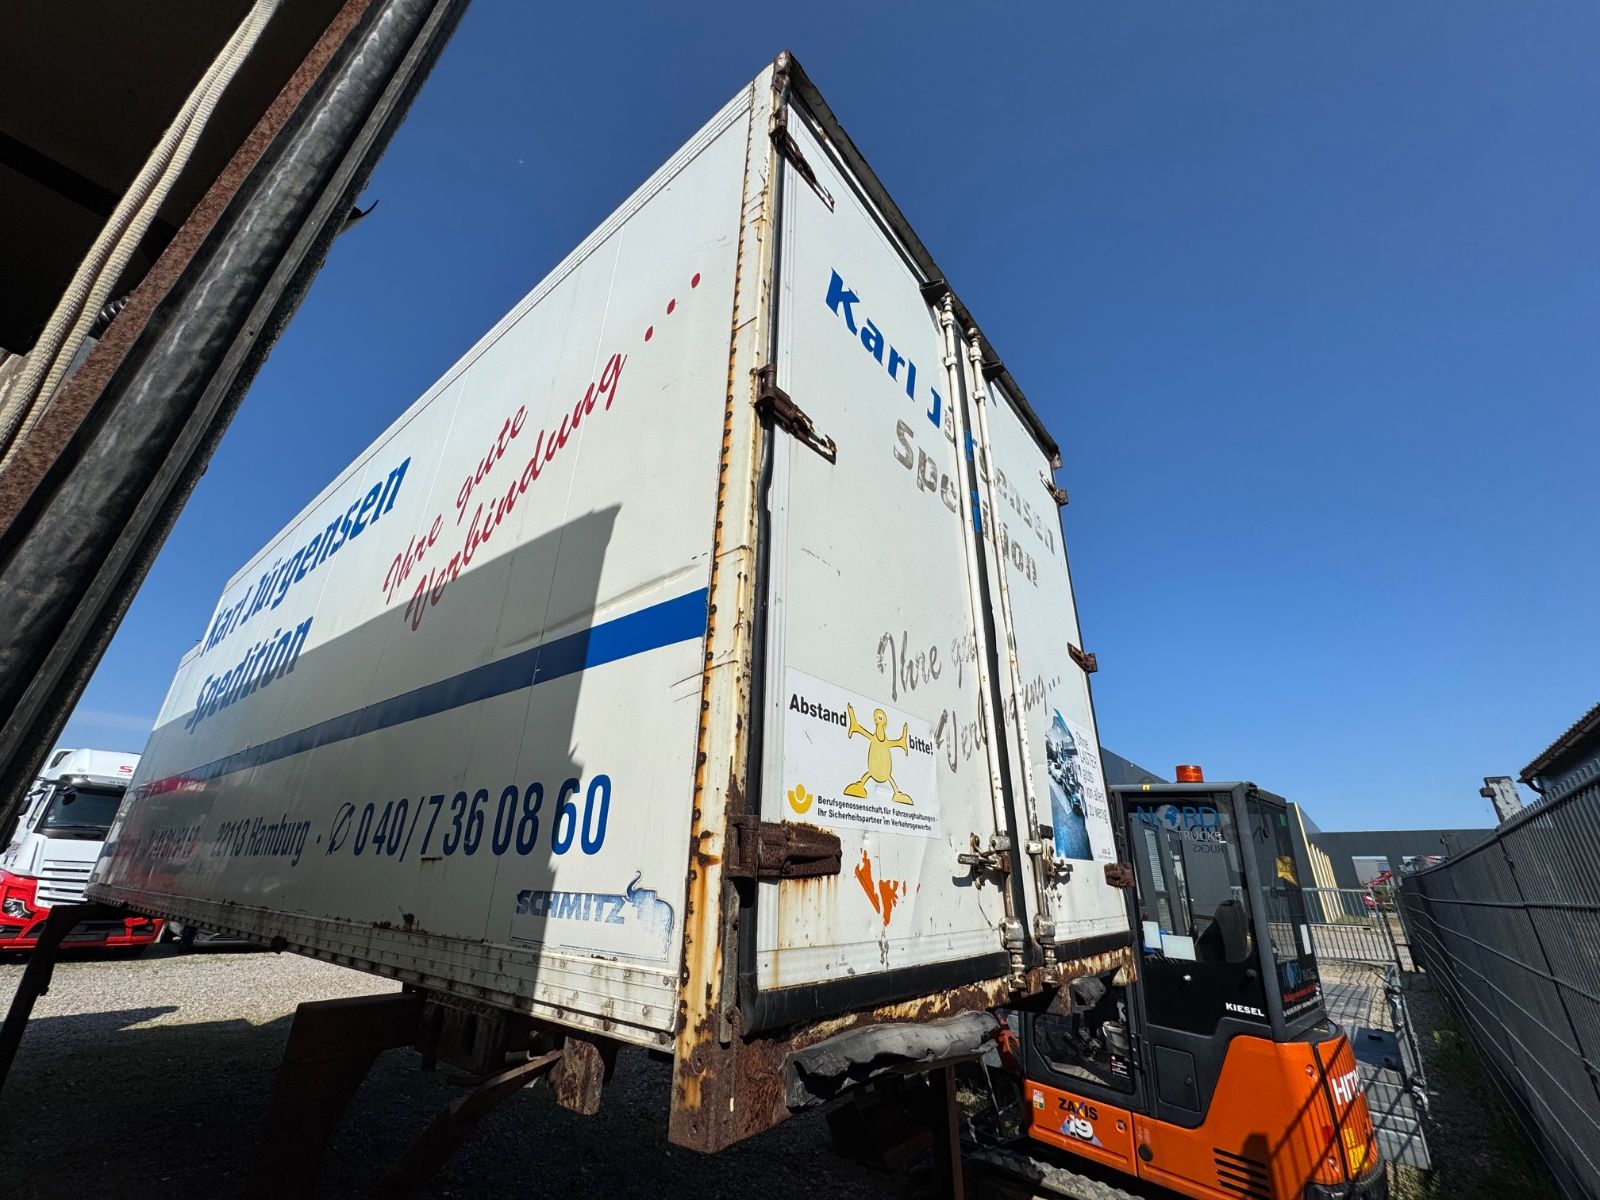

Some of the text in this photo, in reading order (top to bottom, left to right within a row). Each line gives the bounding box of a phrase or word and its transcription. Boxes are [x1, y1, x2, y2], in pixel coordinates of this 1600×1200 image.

[825, 266, 917, 402] Karl
[382, 405, 528, 605] Ihre gute
[404, 353, 628, 632] Verbindung
[200, 456, 412, 658] Karl Jürgensen
[184, 616, 314, 736] Spedition
[877, 630, 942, 702] Ihre
[789, 693, 847, 728] Abstand
[908, 734, 934, 756] bitte!
[817, 808, 827, 817] Ihr
[828, 809, 883, 824] Sicherheitspartner
[891, 818, 932, 832] Verkehrsgewerbe
[818, 796, 883, 814] Berufsgenossenschaft
[883, 807, 891, 816] für
[244, 813, 311, 868] Hamburg
[515, 889, 626, 925] SCHMITZ
[1225, 1002, 1265, 1017] KIESEL
[1058, 1097, 1099, 1121] ZAXIS
